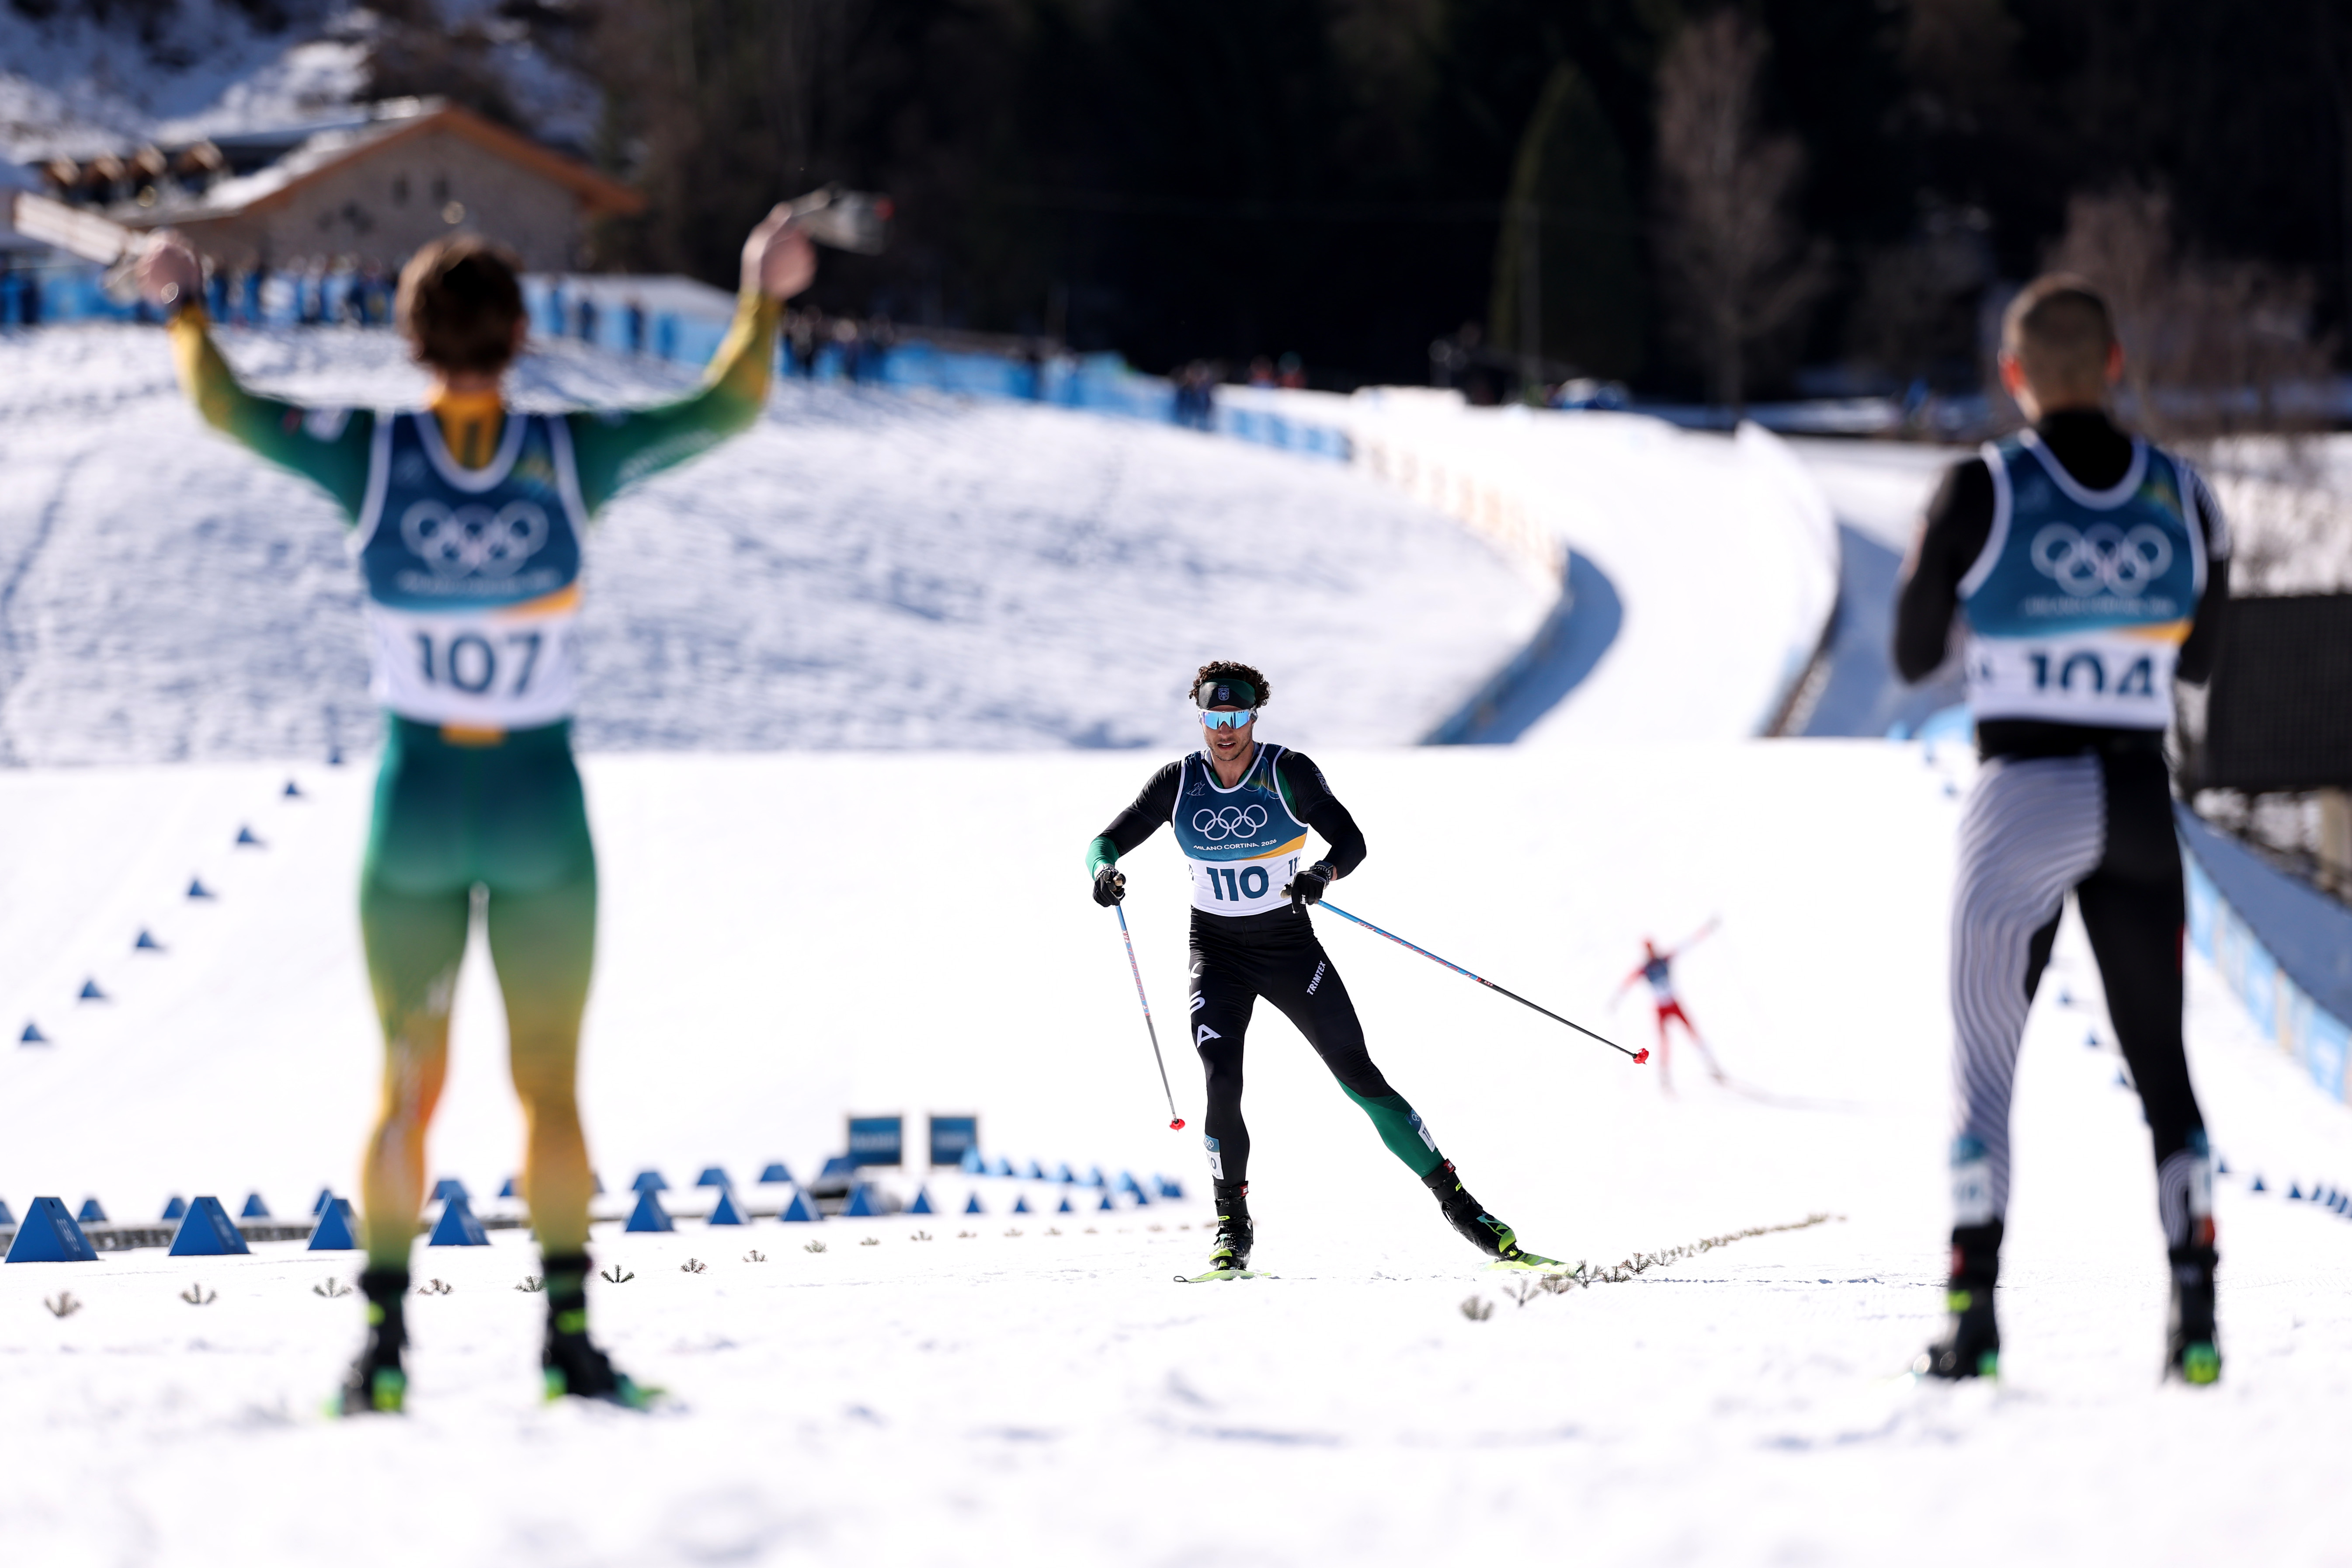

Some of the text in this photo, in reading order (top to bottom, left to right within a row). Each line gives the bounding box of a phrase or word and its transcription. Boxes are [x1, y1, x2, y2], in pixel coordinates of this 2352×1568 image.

[414, 631, 541, 697] 107
[1206, 866, 1269, 901] 110
[1288, 856, 1300, 877] 11
[1306, 960, 1326, 995] TRIMTEX
